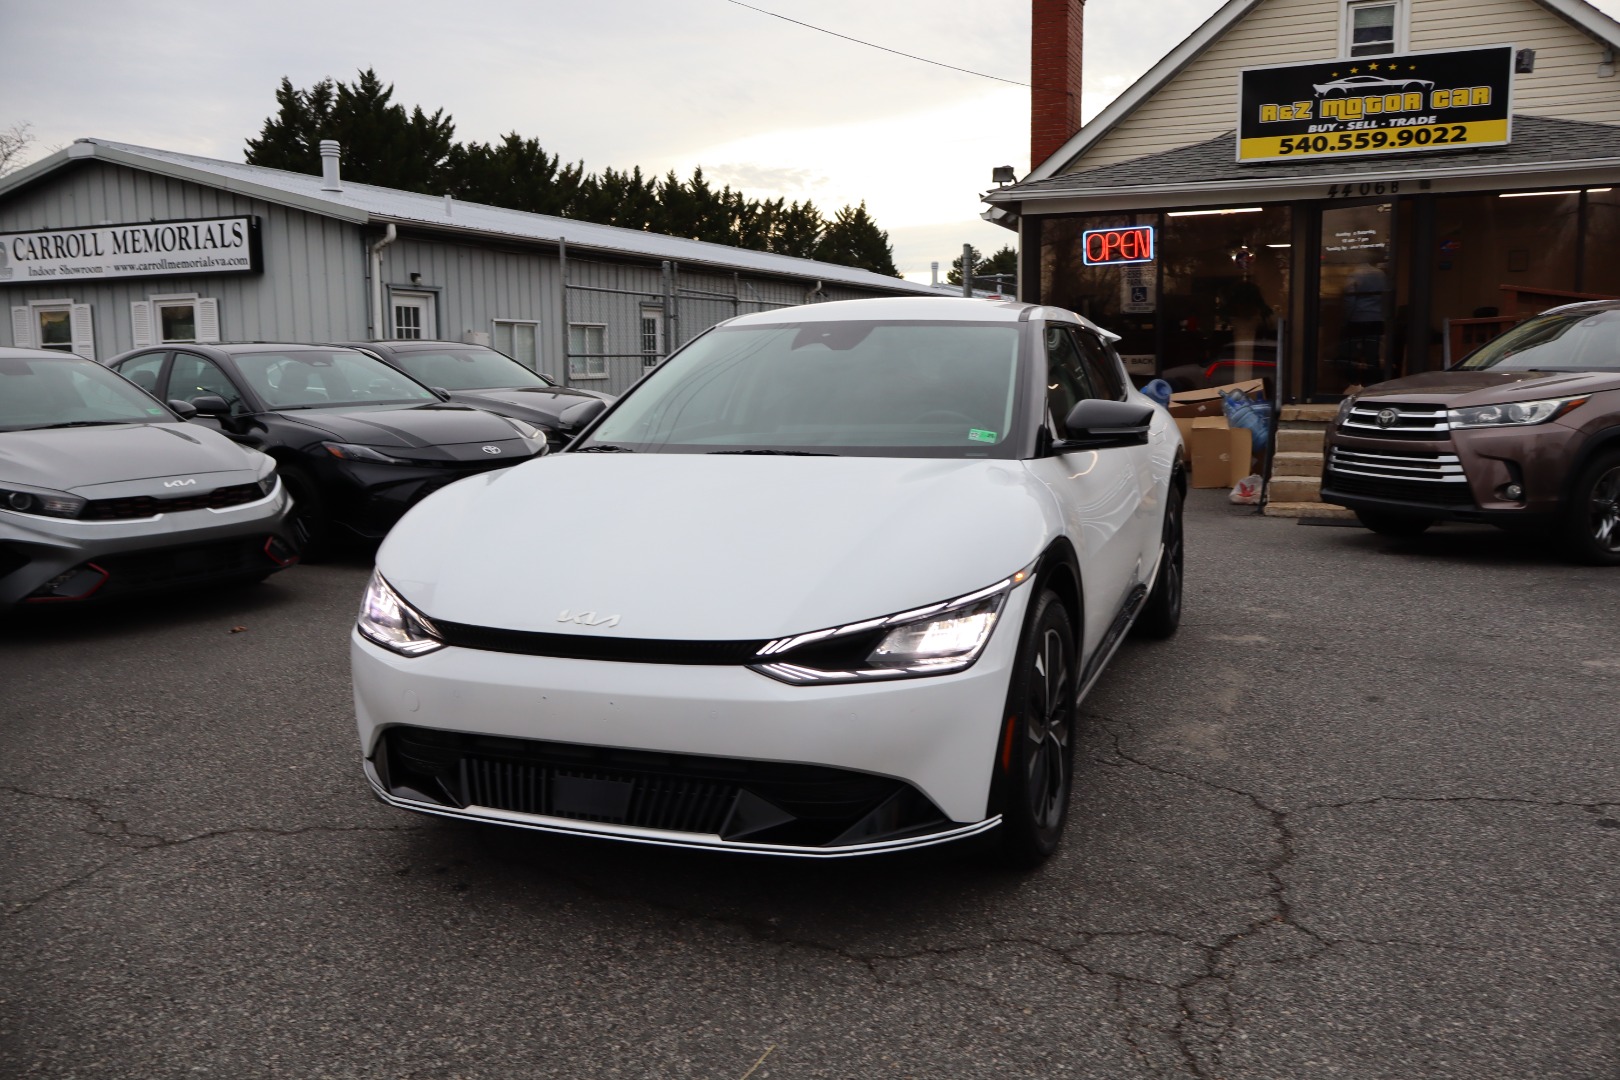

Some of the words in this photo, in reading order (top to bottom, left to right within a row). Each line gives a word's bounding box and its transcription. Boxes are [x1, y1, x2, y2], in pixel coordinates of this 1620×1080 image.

[1259, 101, 1313, 123] R&Z
[1308, 123, 1338, 133] BUY
[1347, 120, 1378, 130] SELL
[1389, 116, 1437, 127] TRADE
[1279, 126, 1467, 154] 540.559.9022
[13, 233, 104, 261] CARROLL
[111, 222, 243, 255] MEMORIALS
[1086, 229, 1150, 262] OPEN
[28, 266, 56, 277] Indoor
[59, 264, 103, 275] Showroom
[114, 256, 248, 271] www.carrollmemorialsva.com
[557, 609, 621, 628] KIA
